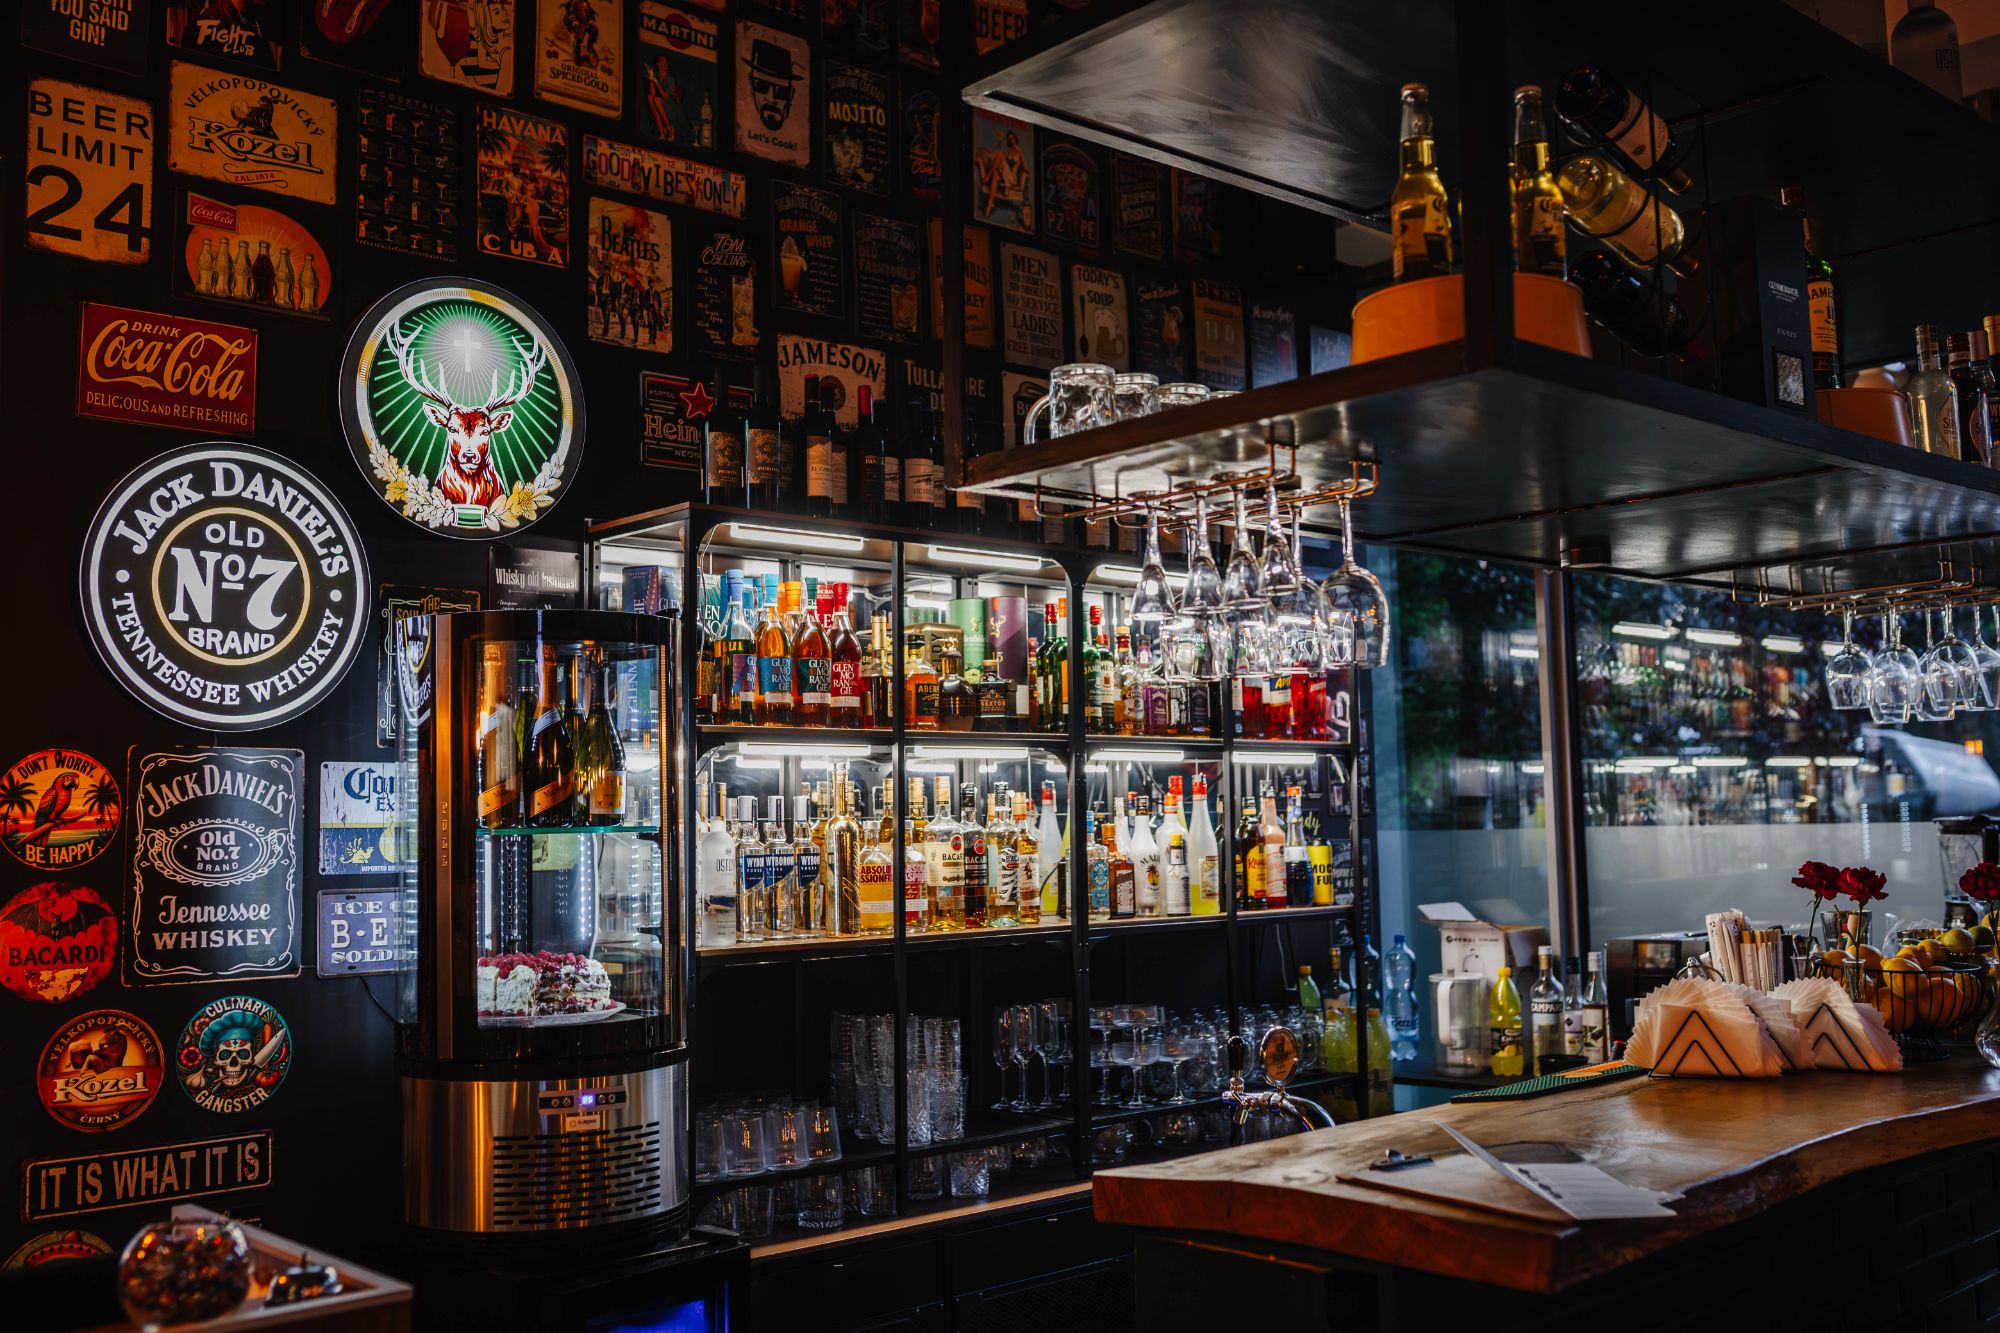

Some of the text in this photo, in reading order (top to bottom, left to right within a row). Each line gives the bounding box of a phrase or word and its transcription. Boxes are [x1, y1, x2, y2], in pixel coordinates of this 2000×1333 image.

[88, 2, 129, 31] SAID
[69, 19, 106, 47] GIN!
[641, 14, 716, 49] MARTINI
[550, 66, 609, 93] SPICED GOLD
[561, 64, 600, 79] ORIGINAL
[30, 89, 151, 140] BEER
[828, 101, 887, 127] MOJITO
[482, 109, 566, 147] HAVANA
[36, 126, 144, 171] LIMIT
[188, 116, 325, 174] Kozel
[748, 129, 798, 152] Let's Cook!
[586, 147, 740, 209] GOOD VIBES ONLY
[25, 164, 151, 253] 24
[779, 218, 819, 234] ORANGE
[601, 214, 661, 265] BEATLES
[713, 232, 745, 253] TOM
[805, 234, 834, 249] WHIP
[1011, 253, 1049, 278] MEN
[1076, 267, 1121, 289] TODAY'S
[1021, 296, 1059, 314] SERVICE
[1087, 289, 1115, 307] SOUP
[131, 321, 181, 338] DRINK
[1012, 310, 1059, 337] LADIES
[1006, 340, 1028, 354] FREE
[86, 319, 252, 402] Coca-Cola
[779, 341, 882, 383] JAMESON
[86, 389, 249, 427] DELICIOUS AND REFRESHING
[112, 460, 350, 579] JACK DANIEL'S
[205, 520, 266, 549] OLD
[495, 567, 526, 589] Whisky
[527, 573, 541, 588] old
[420, 596, 441, 614] THE
[111, 591, 241, 706] TENNESSEE
[246, 608, 345, 704] WHISKEY
[188, 626, 276, 656] BRAND
[771, 658, 791, 667] GLEN
[808, 658, 829, 668] GLEN
[832, 663, 854, 672] GLEN
[833, 679, 850, 687] RAN
[839, 671, 855, 680] MO
[839, 686, 853, 695] GIE
[16, 756, 48, 780] DON'T
[145, 763, 288, 818] JACK DANIEL'S
[199, 830, 236, 846] Old
[25, 841, 95, 864] BE HAPPY
[196, 846, 242, 862] No.7
[196, 861, 240, 873] BRAND
[158, 895, 272, 925] Tennessee
[330, 900, 383, 916] ICE
[152, 928, 278, 950] WHISKEY
[9, 943, 105, 967] BACARDI
[331, 948, 393, 964] SOLD
[205, 996, 270, 1018] CULINARY
[52, 1072, 150, 1103] Kozel
[194, 1086, 270, 1113] GANGSTER
[40, 1140, 261, 1210] IT IS WHAT IT IS
